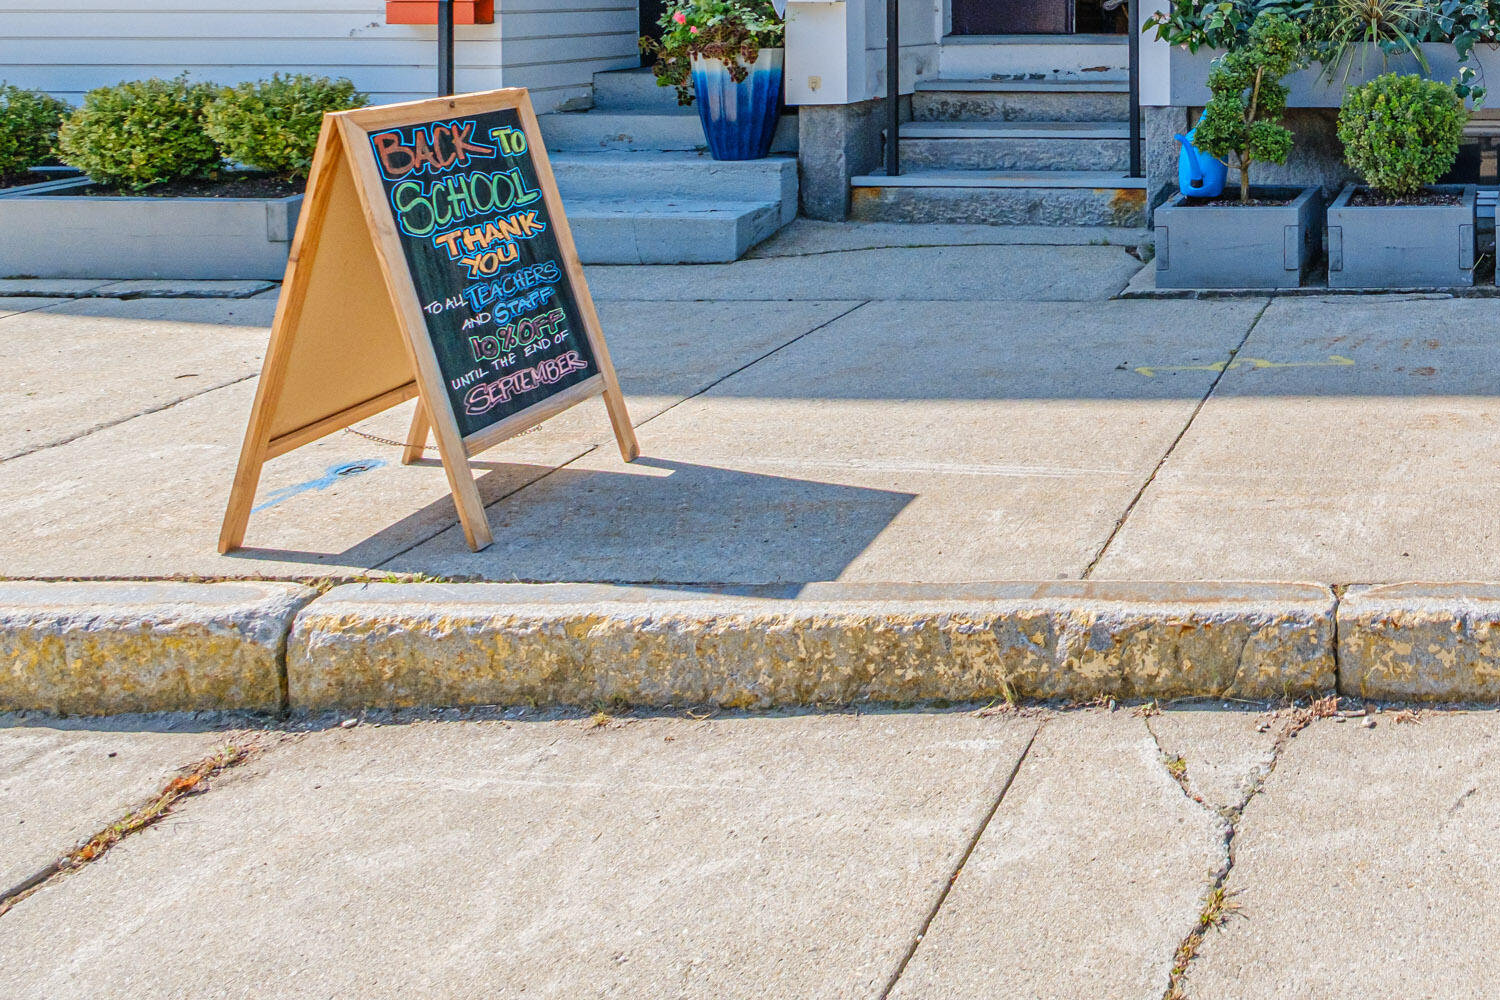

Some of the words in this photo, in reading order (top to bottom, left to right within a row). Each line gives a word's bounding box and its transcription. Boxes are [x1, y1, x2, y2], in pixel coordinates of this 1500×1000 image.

[370, 120, 497, 181] BACK
[391, 167, 542, 237] SCHOOL
[433, 210, 547, 260] THANK
[458, 242, 520, 279] YOU
[424, 300, 443, 315] TO
[445, 294, 469, 310] ALL
[463, 260, 562, 312] TEACHERS
[462, 312, 491, 331] AND
[492, 287, 556, 326] STAFF
[452, 368, 490, 391] UNTIL
[491, 353, 517, 371] THE
[525, 338, 551, 357] END
[554, 330, 569, 345] OF
[464, 351, 588, 416] SEPTEMBER
